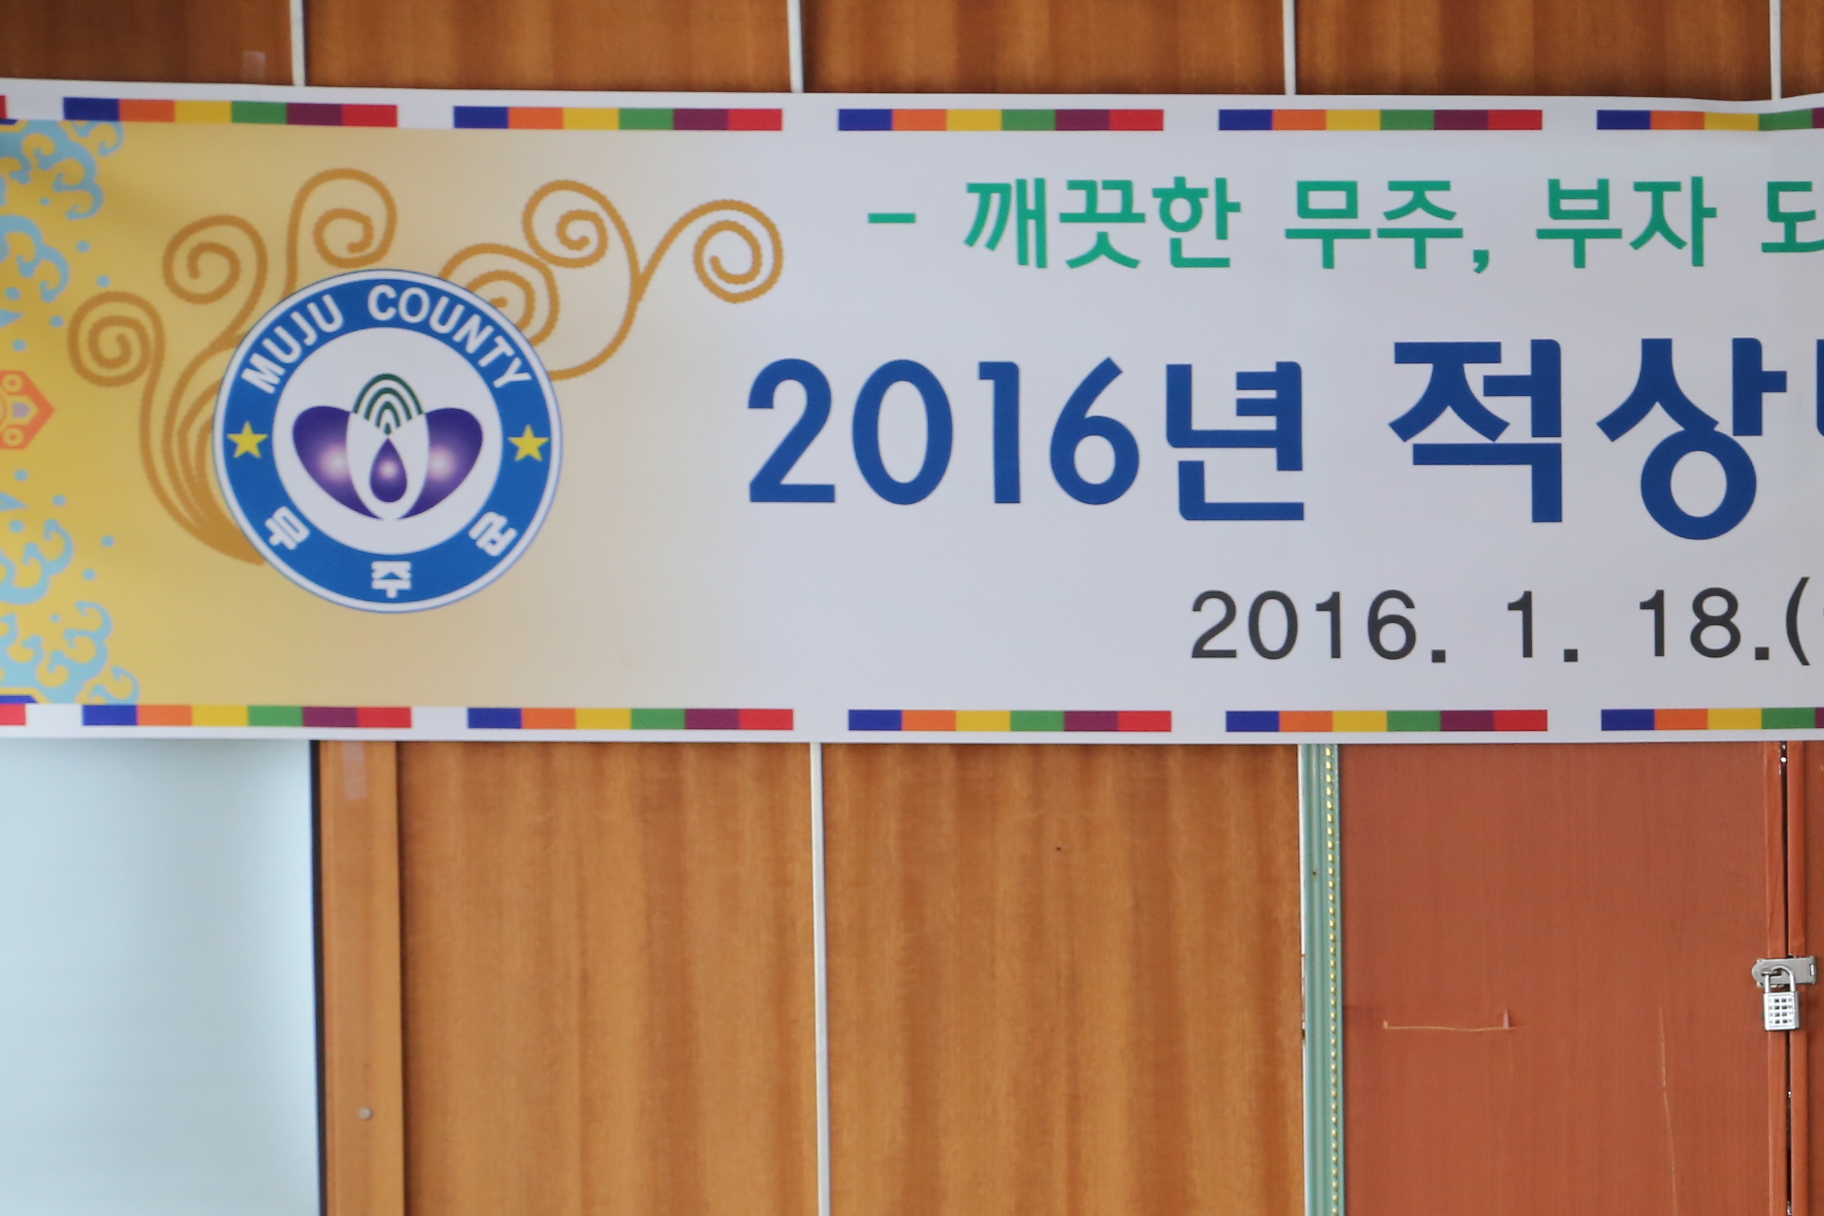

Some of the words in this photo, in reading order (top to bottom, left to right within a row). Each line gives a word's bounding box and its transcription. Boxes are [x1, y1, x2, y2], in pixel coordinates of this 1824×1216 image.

[964, 175, 1242, 269] 깨끗한
[1284, 179, 1490, 274] 무주,
[1536, 175, 1718, 269] 부자
[240, 293, 345, 394] MUJU
[366, 284, 532, 389] COUNTY
[747, 356, 1305, 521] 2016년
[1191, 589, 1446, 664] 2016.
